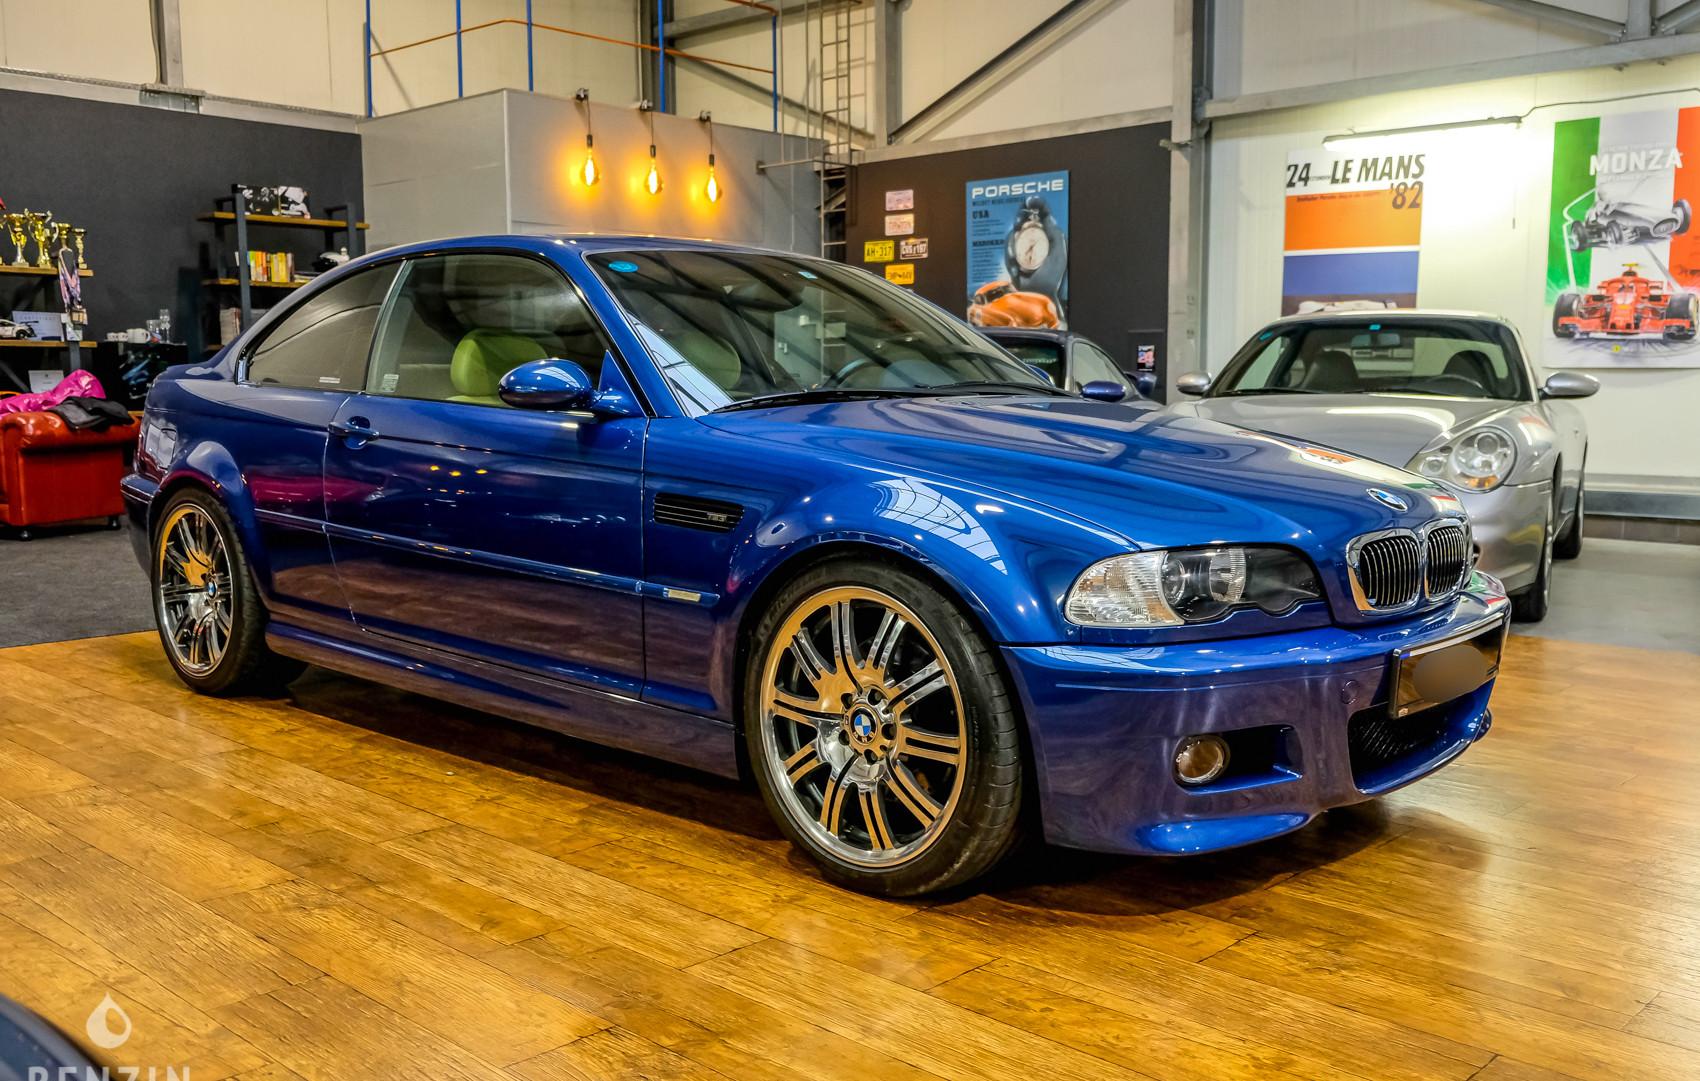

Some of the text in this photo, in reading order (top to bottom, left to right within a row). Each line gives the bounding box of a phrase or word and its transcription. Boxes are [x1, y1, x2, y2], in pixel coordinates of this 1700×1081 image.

[1285, 153, 1426, 188] 24 LE MANS
[1590, 147, 1683, 176] MONZA
[971, 179, 1064, 199] PORSCHE
[1390, 180, 1424, 210] '82
[972, 210, 990, 219] USA
